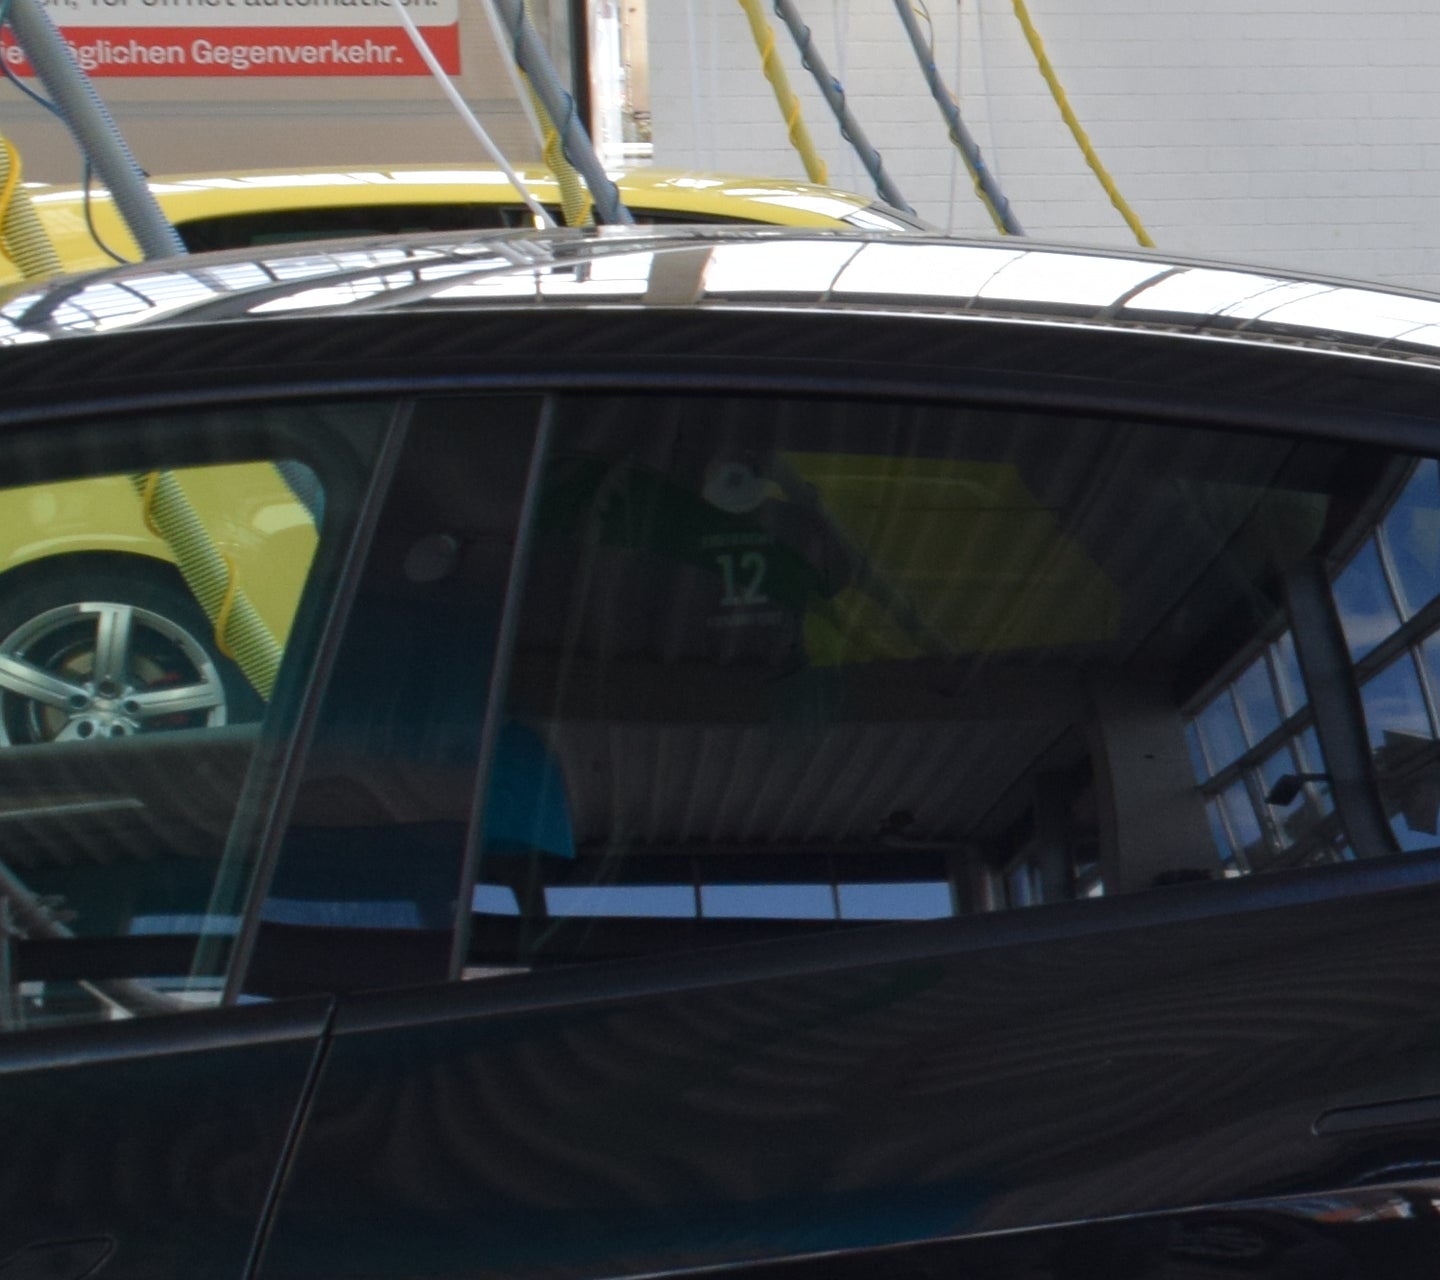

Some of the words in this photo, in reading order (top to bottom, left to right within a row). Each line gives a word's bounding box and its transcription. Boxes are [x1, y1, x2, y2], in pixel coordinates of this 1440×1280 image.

[0, 38, 24, 65] ie
[67, 37, 186, 70] öglichen
[191, 38, 404, 71] Gegenverkehr.
